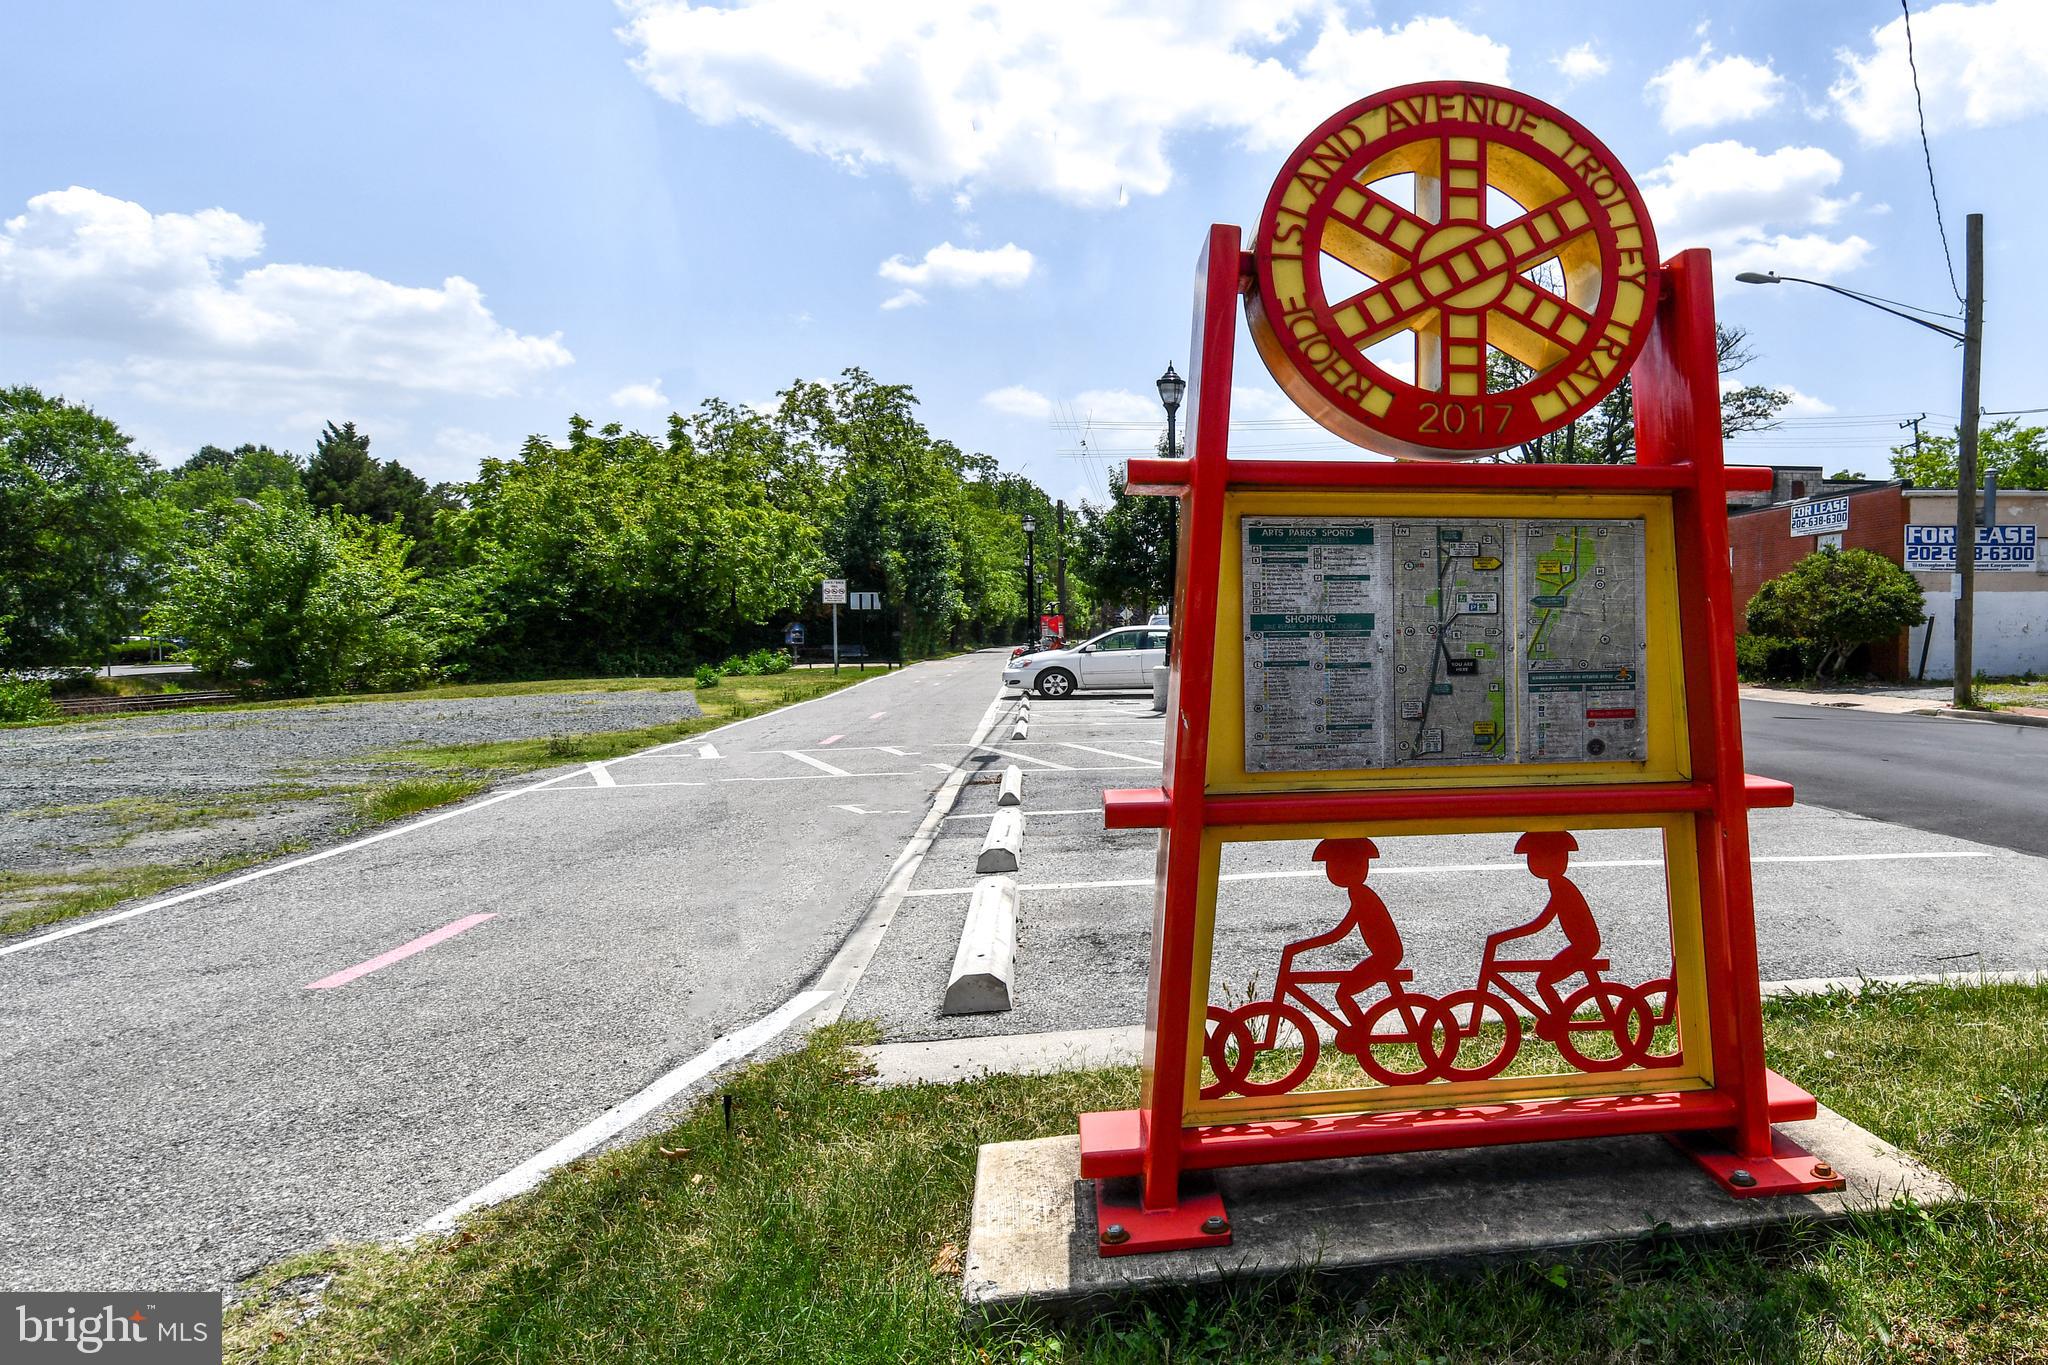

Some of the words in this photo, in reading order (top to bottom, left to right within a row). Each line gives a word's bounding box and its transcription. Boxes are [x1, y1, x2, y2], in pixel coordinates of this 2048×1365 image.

[1386, 93, 1543, 139] AVENUE
[1272, 124, 1366, 259] ISLAND
[1560, 134, 1647, 290] TROLLEY
[1283, 296, 1373, 405] RHODE
[1538, 319, 1642, 412] TRAIL
[1418, 402, 1514, 434] 2017
[1792, 512, 1847, 529] 202-638-6300
[1793, 505, 1812, 518] FOR
[1814, 499, 1847, 514] LEASE
[1261, 529, 1284, 537] ARTS
[1288, 529, 1317, 537] PARKS
[1322, 529, 1355, 537] SPORTS
[1908, 527, 1954, 543] FOR
[1974, 527, 2034, 543] EASE
[1907, 546, 2034, 561] 202-68-6300
[1284, 615, 1337, 624] SHOPPING
